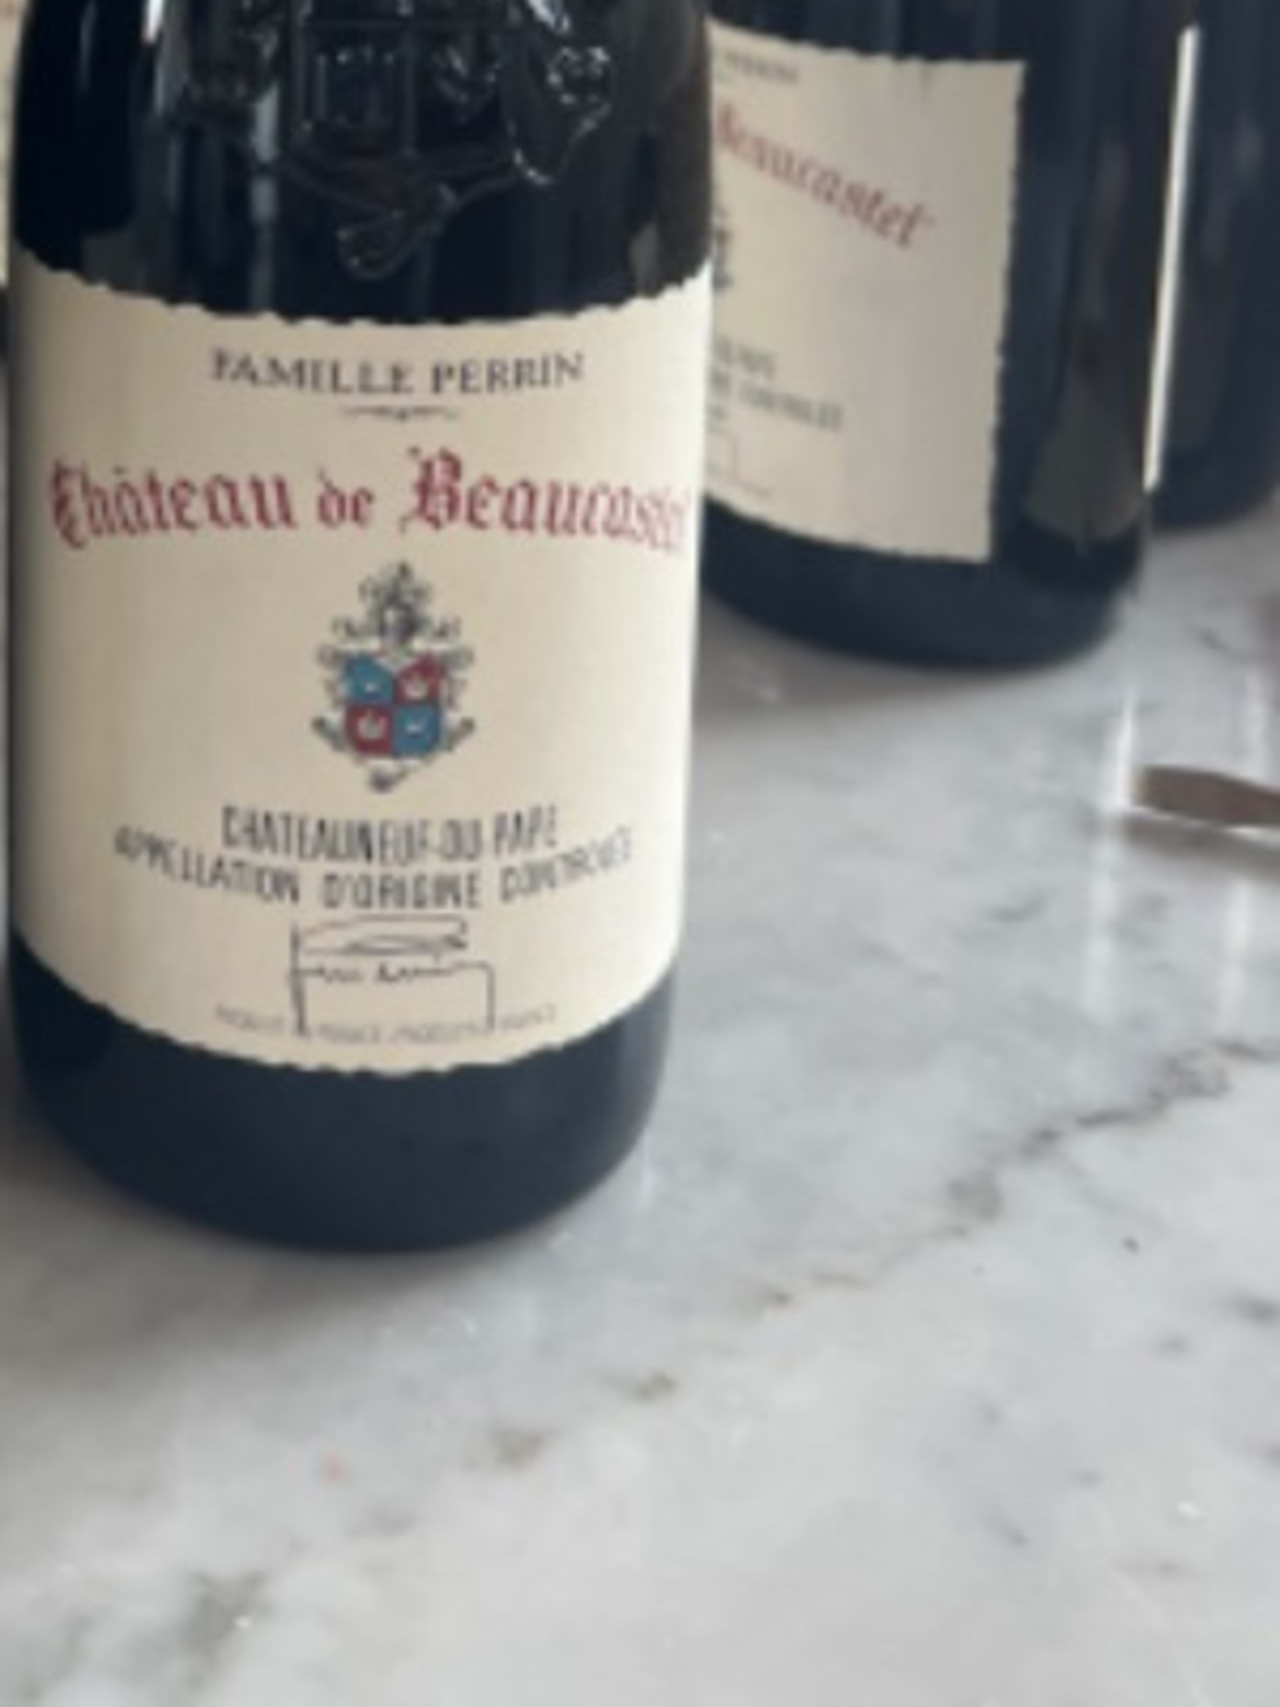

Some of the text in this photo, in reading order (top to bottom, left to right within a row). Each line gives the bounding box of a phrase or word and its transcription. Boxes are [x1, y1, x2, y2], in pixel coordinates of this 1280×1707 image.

[211, 345, 586, 394] FAMILLE PERRIN
[318, 464, 375, 530] de
